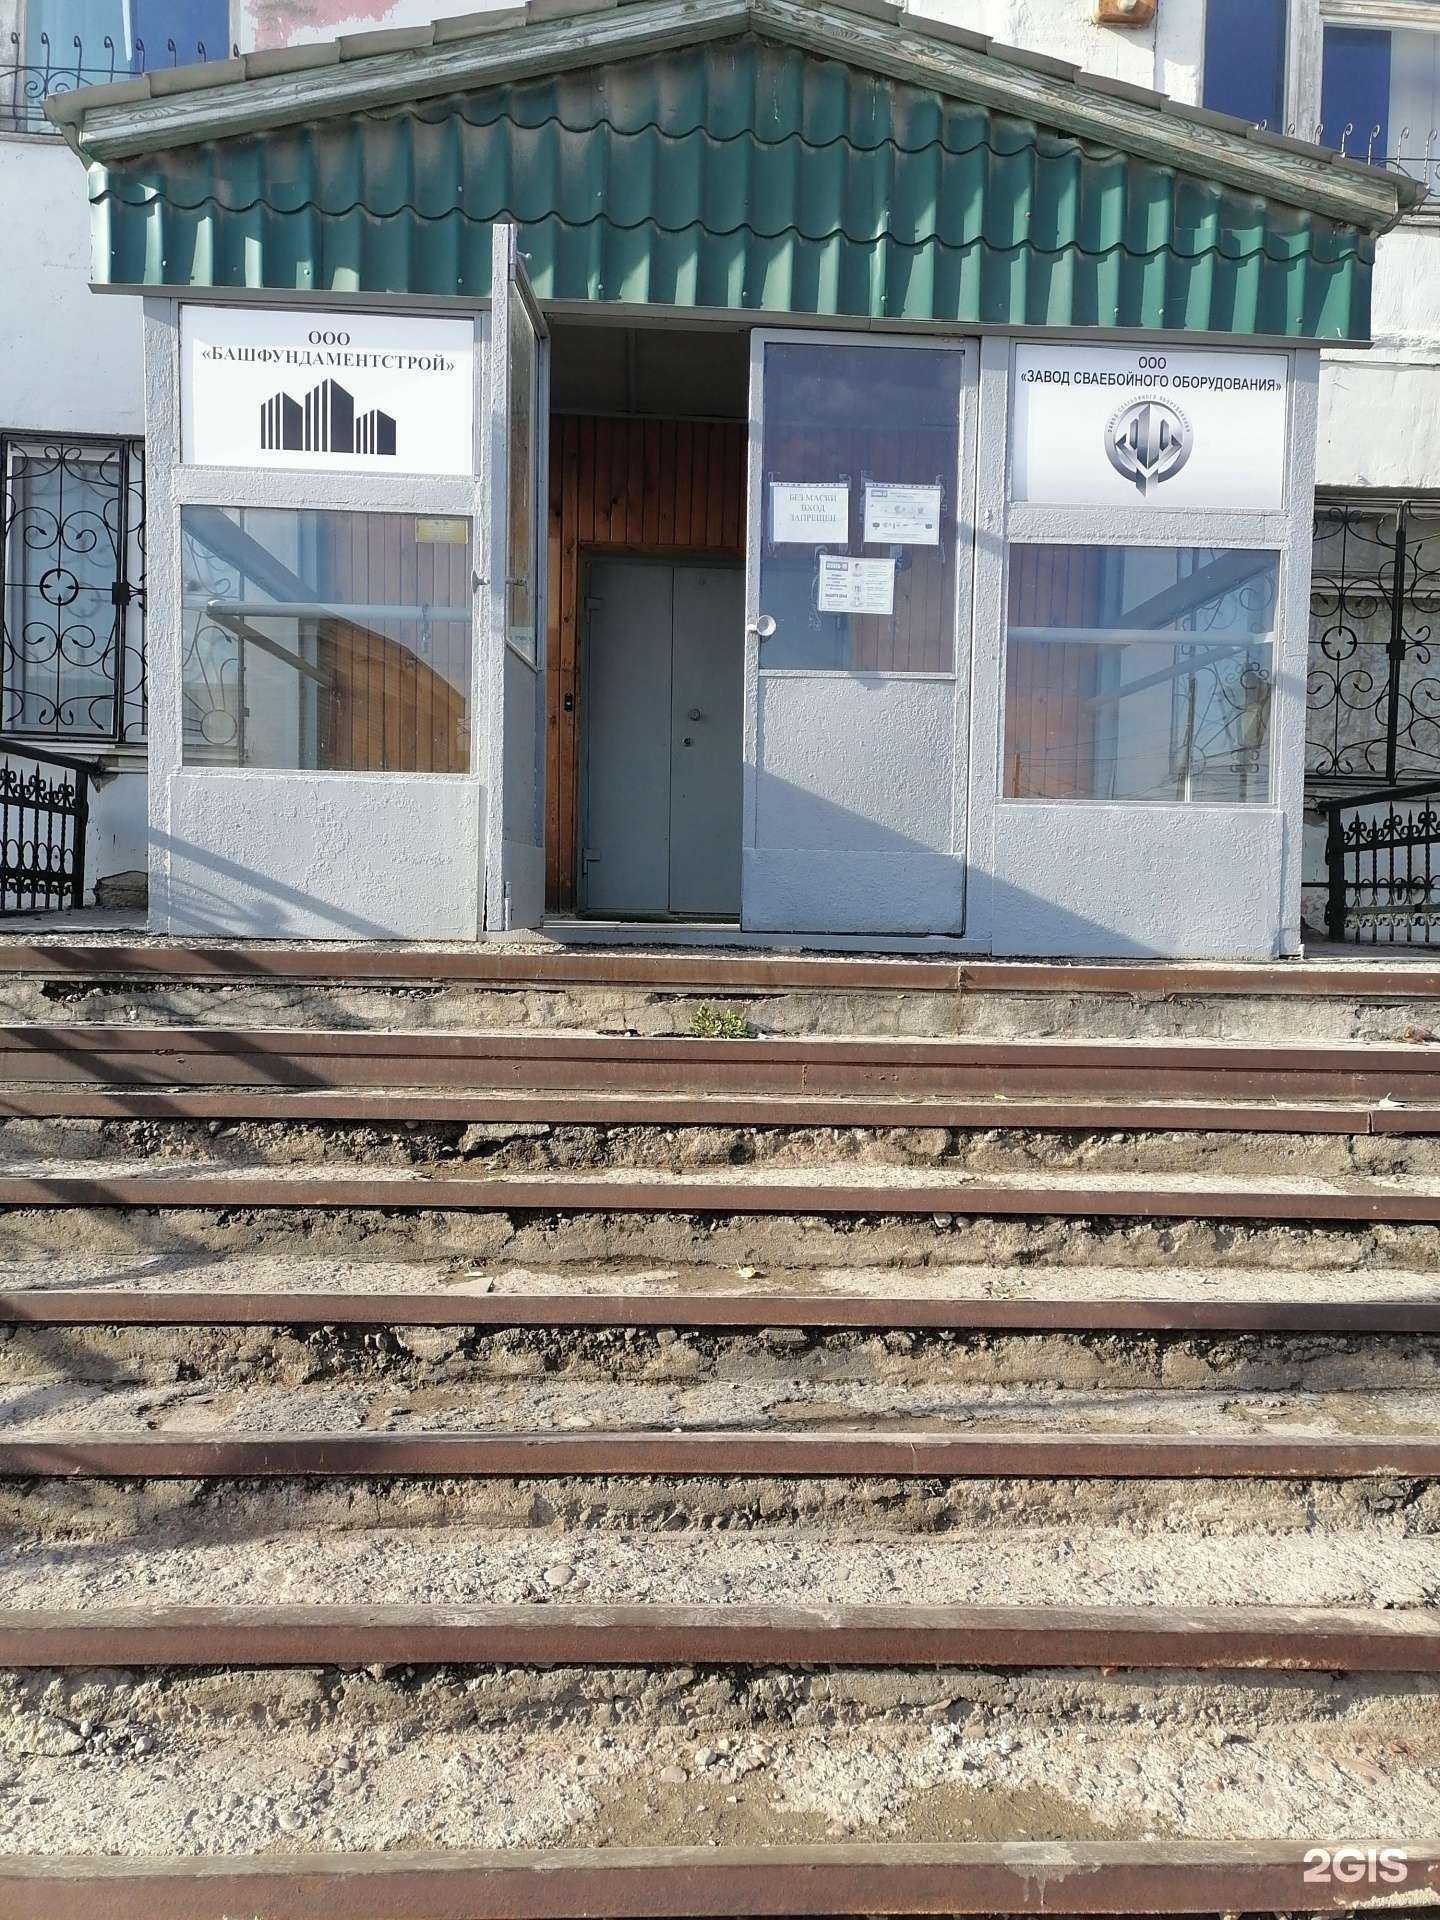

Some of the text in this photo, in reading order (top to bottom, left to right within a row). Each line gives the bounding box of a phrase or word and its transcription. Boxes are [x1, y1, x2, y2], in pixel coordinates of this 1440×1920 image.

[308, 331, 351, 346] ООО
[202, 346, 455, 371] «БАШФУНДАМЕНТСТРОЙ»
[1138, 356, 1167, 370] ООО
[1021, 370, 1282, 392] «ЗАВОД СВАЕБОЙНОГО ОБОРУДОВАНИЯ»
[804, 494, 837, 502] МАСКИ
[800, 504, 825, 513] ВХОД
